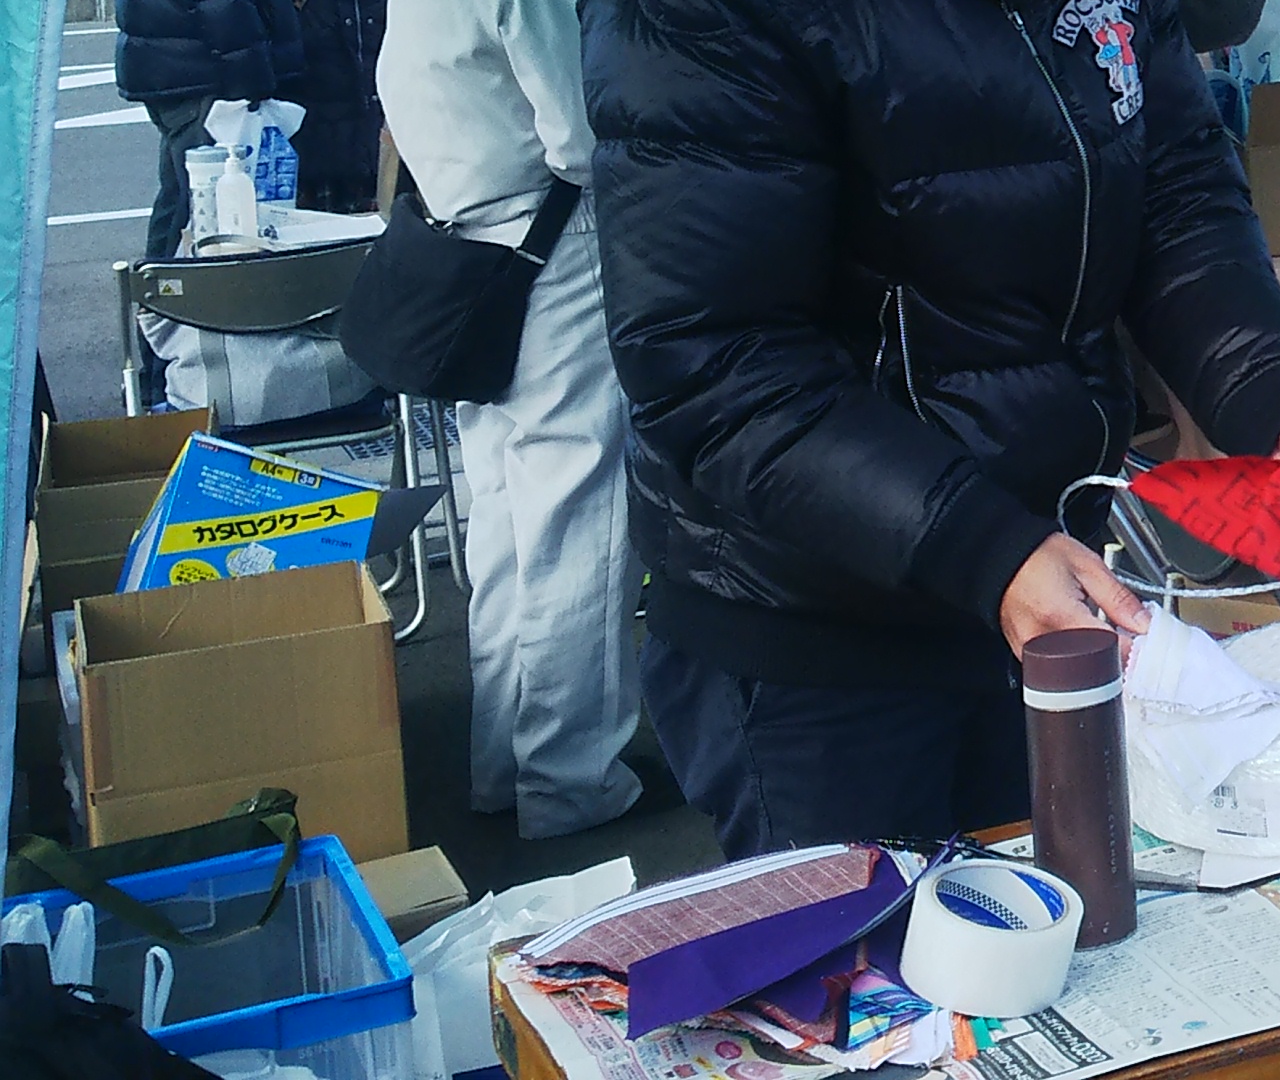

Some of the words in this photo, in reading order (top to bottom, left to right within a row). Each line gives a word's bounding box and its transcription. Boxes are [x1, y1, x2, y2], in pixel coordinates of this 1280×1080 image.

[192, 503, 345, 545] カタログケース
